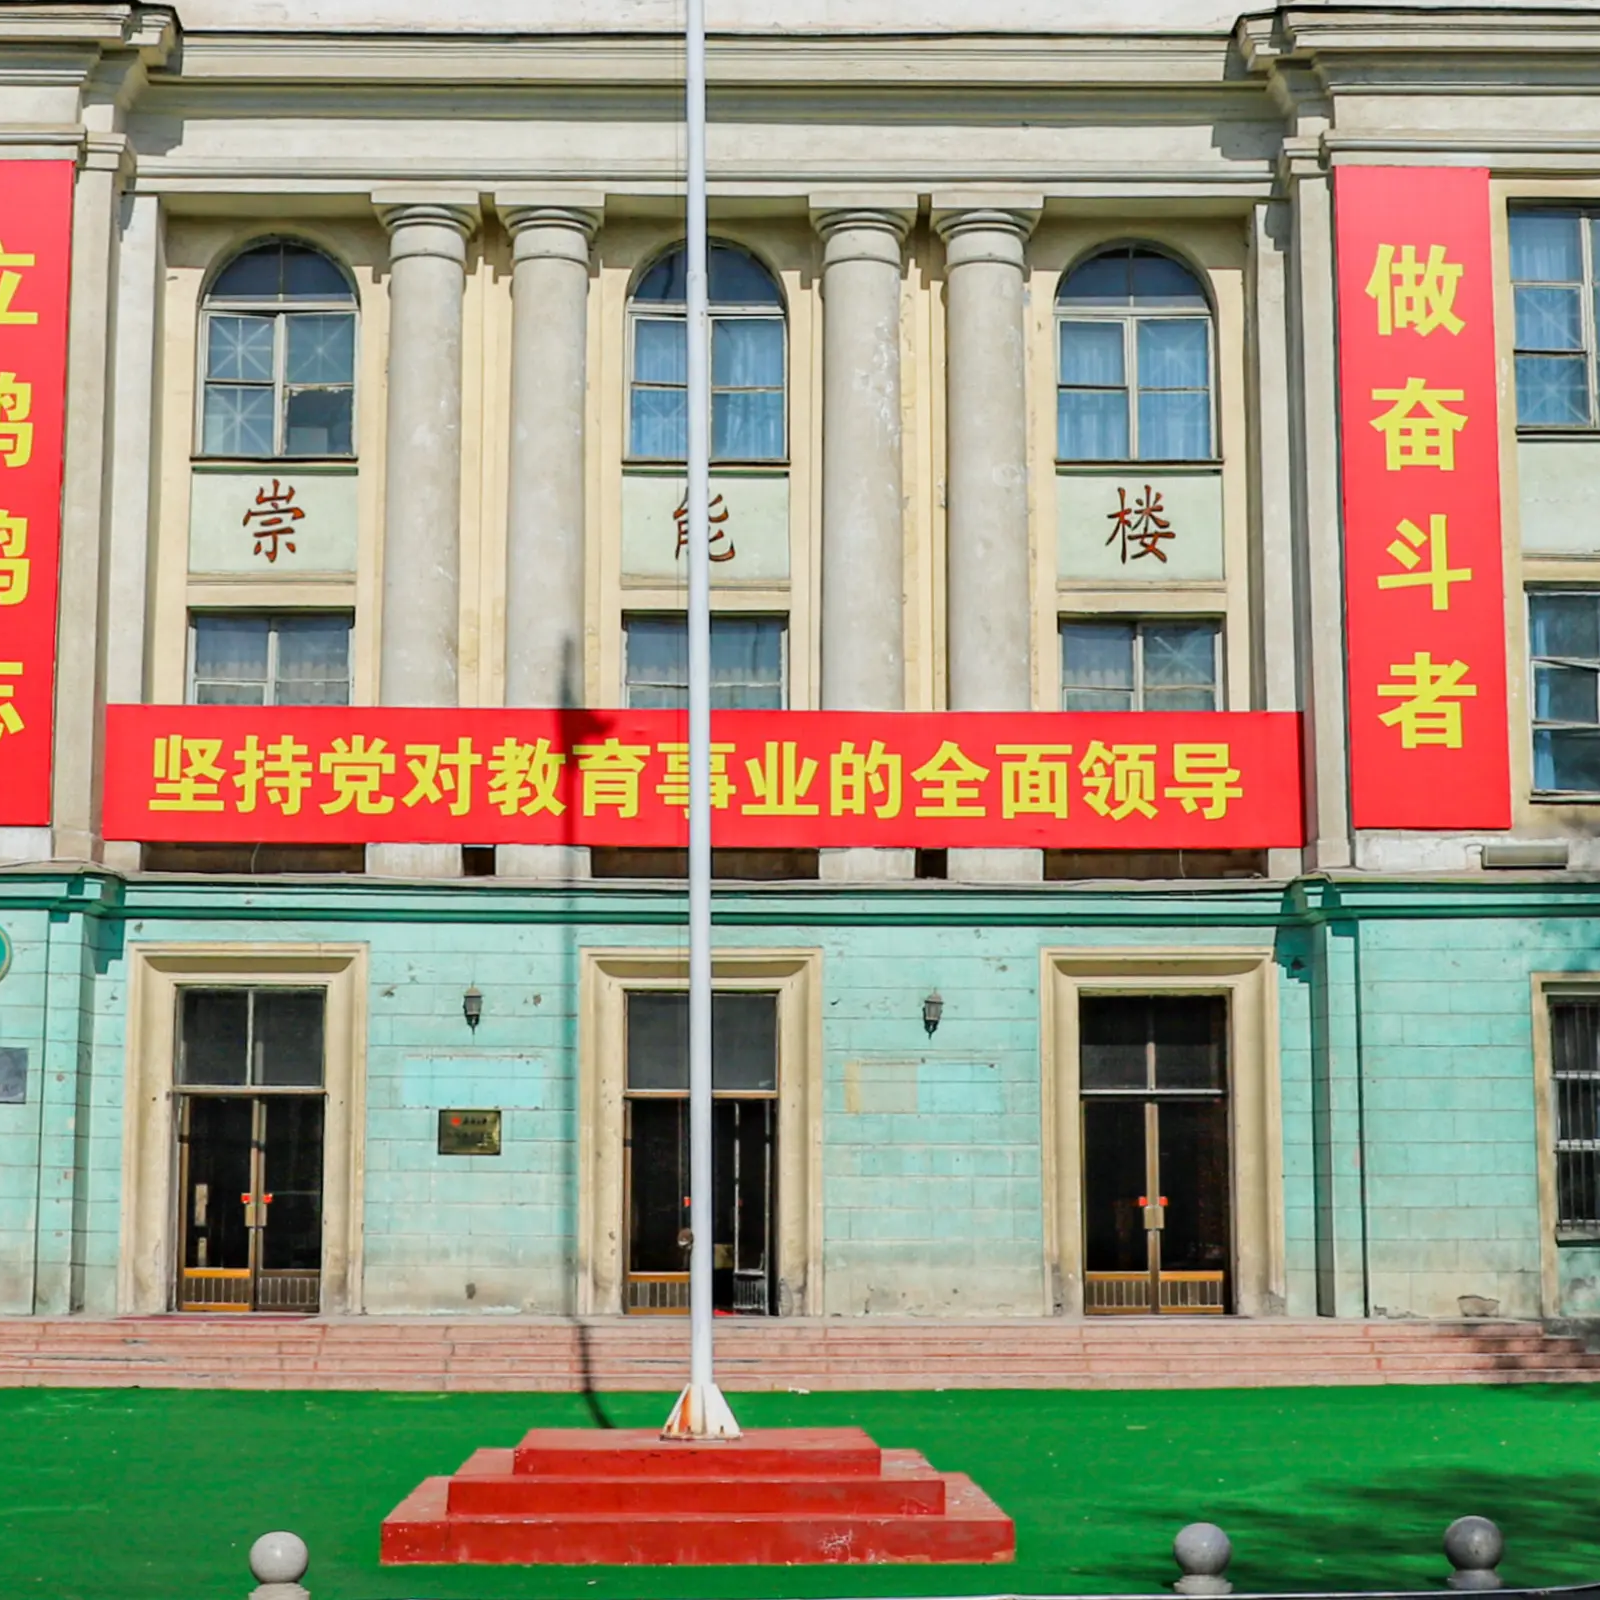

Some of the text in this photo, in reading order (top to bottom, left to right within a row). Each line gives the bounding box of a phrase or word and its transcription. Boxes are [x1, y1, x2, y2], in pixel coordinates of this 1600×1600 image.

[1365, 243, 1478, 750] 做奋斗者
[148, 733, 1244, 821] 坚持党对教育事业的全面领导
